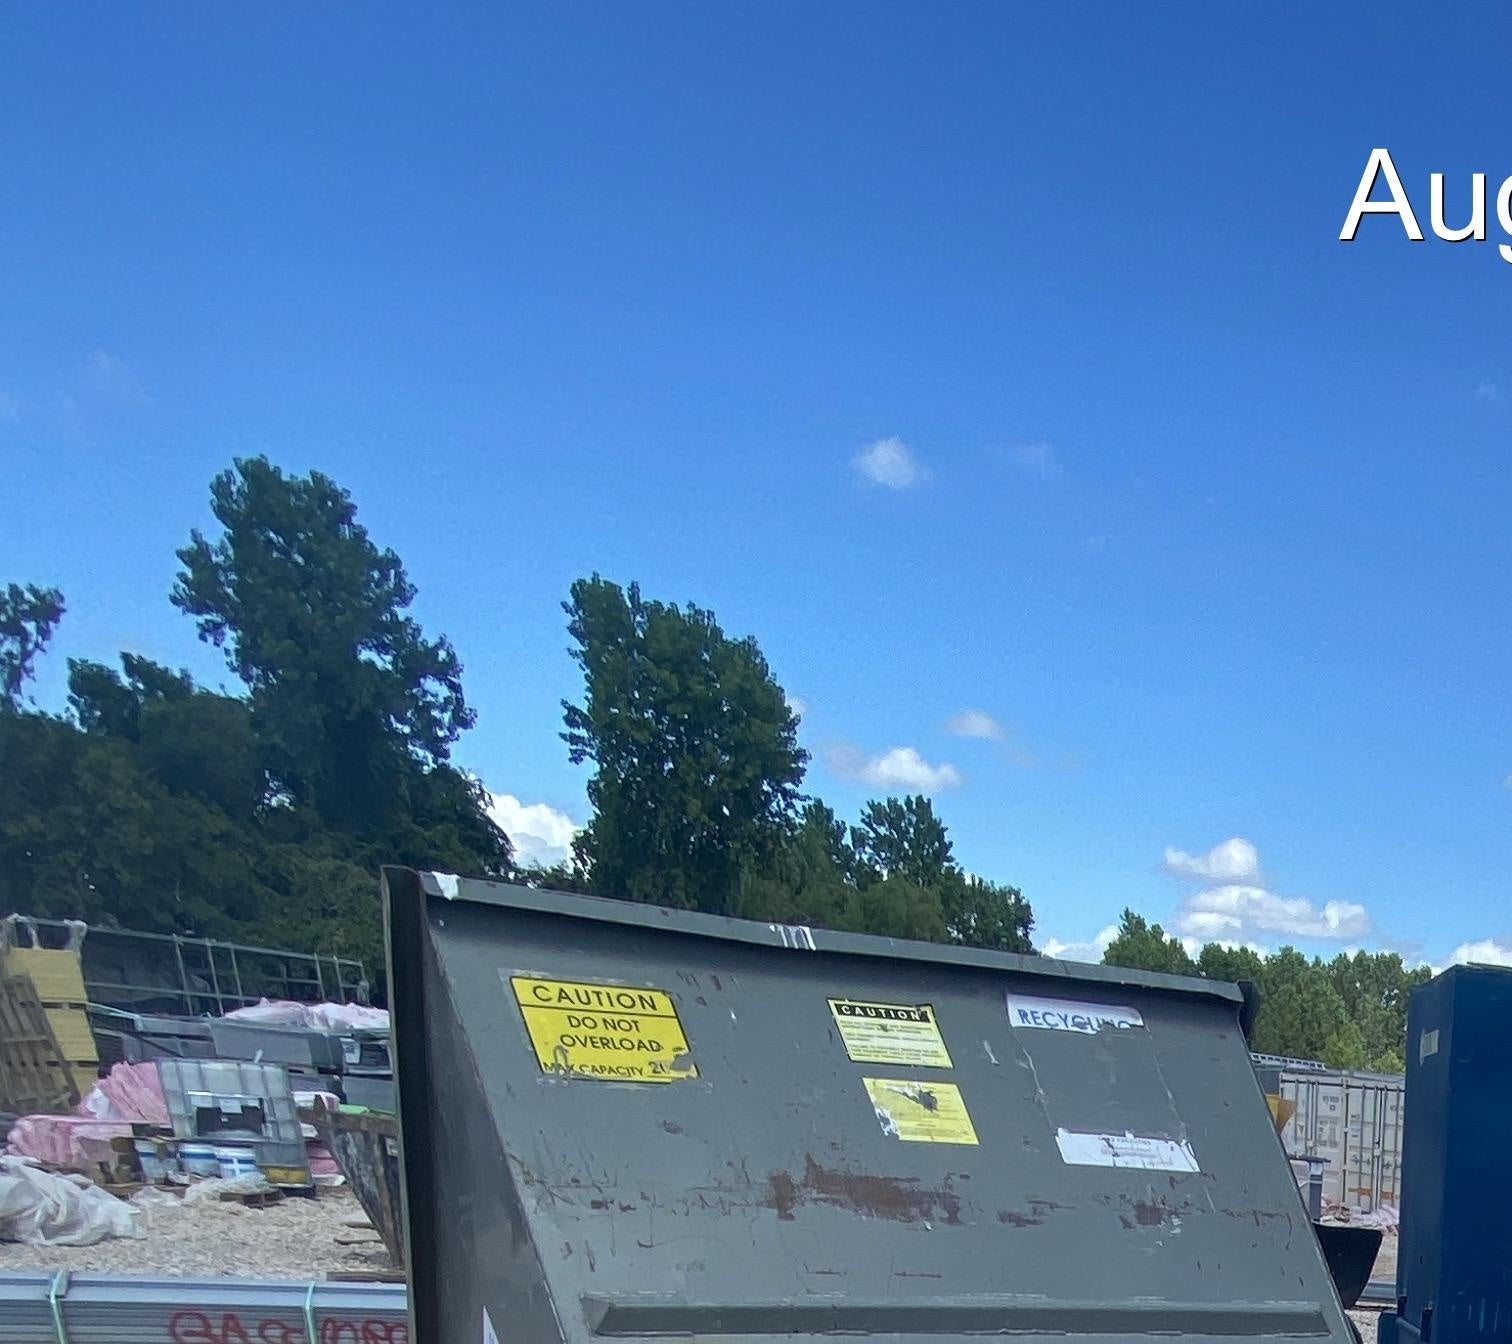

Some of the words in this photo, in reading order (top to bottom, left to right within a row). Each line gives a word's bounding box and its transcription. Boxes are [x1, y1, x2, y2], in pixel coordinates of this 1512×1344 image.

[532, 985, 658, 1011] CAUTION
[841, 1005, 921, 1021] CAUTION
[566, 1014, 598, 1030] DO
[602, 1017, 641, 1033] NOT
[560, 1033, 664, 1053] OVERLOAD
